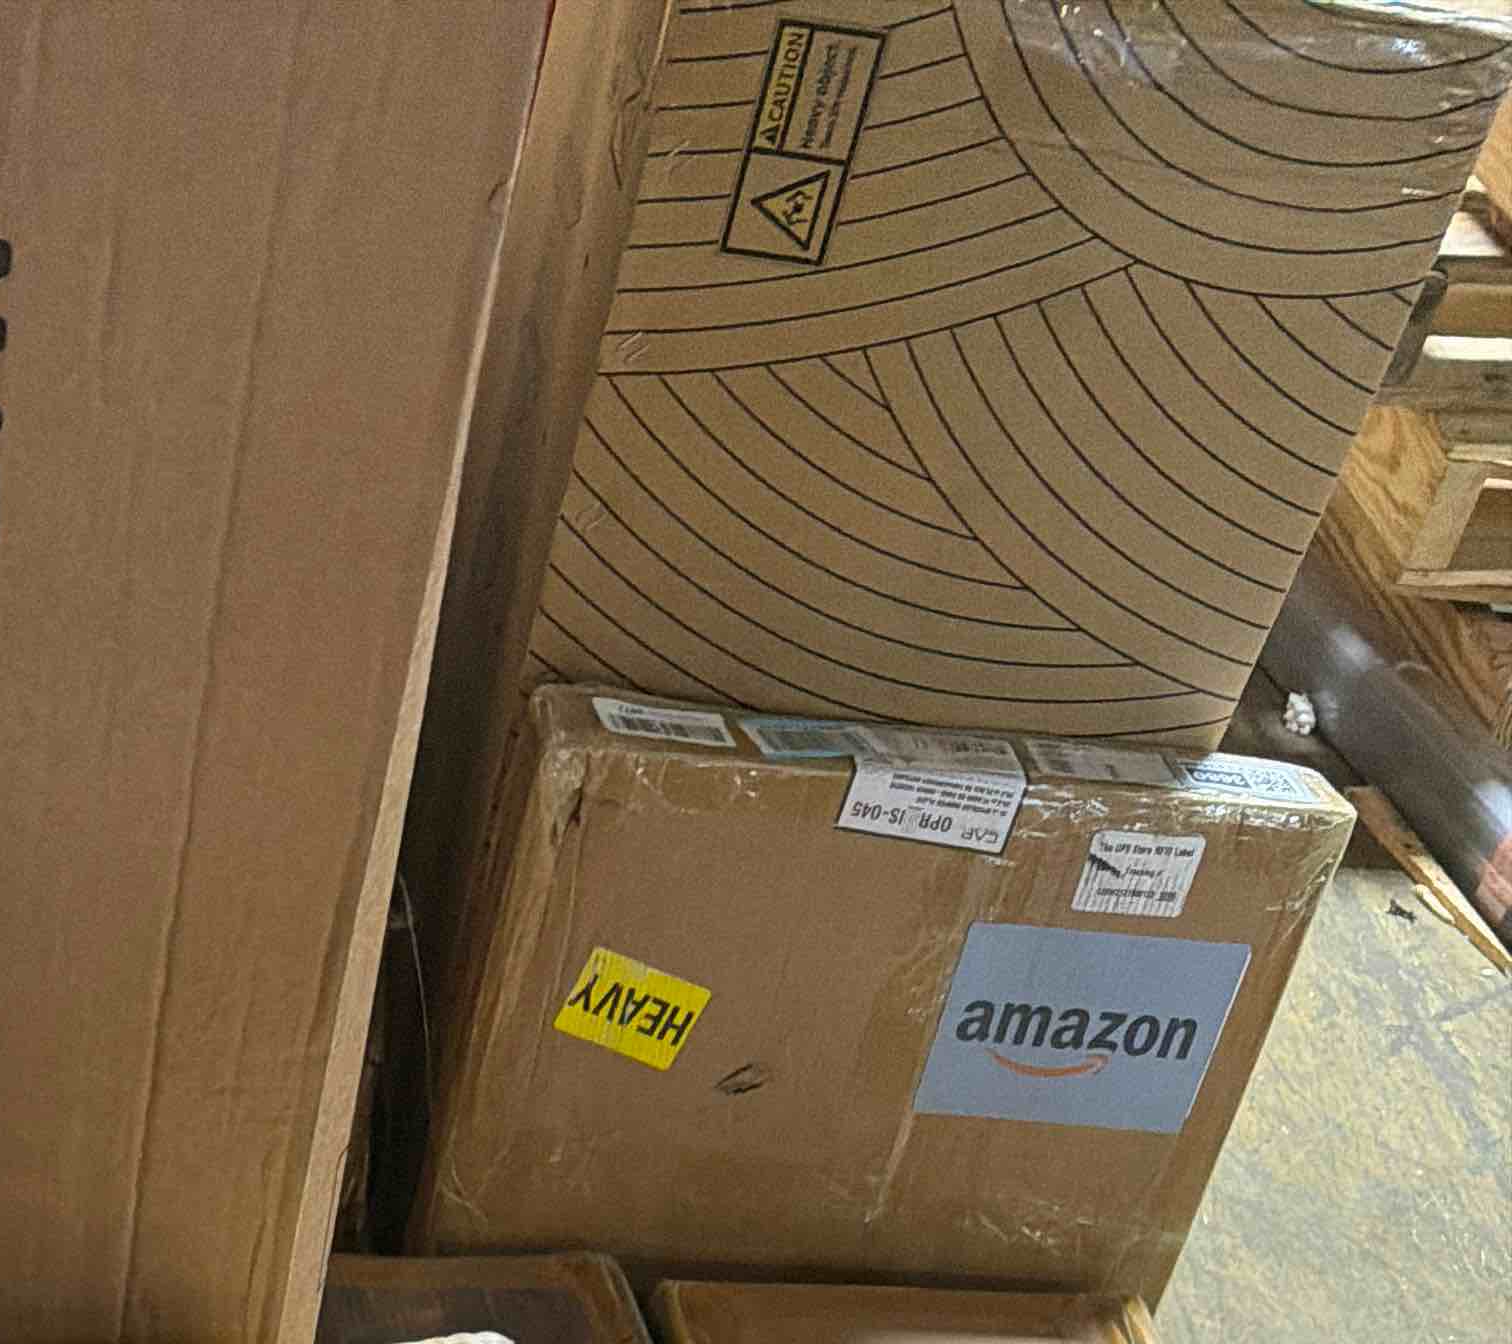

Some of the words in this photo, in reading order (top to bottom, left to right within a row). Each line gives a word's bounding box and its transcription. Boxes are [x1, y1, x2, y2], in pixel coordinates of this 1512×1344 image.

[768, 32, 804, 121] CAUTION
[568, 973, 695, 1046] HEAVY
[955, 999, 1199, 1060] amazon
